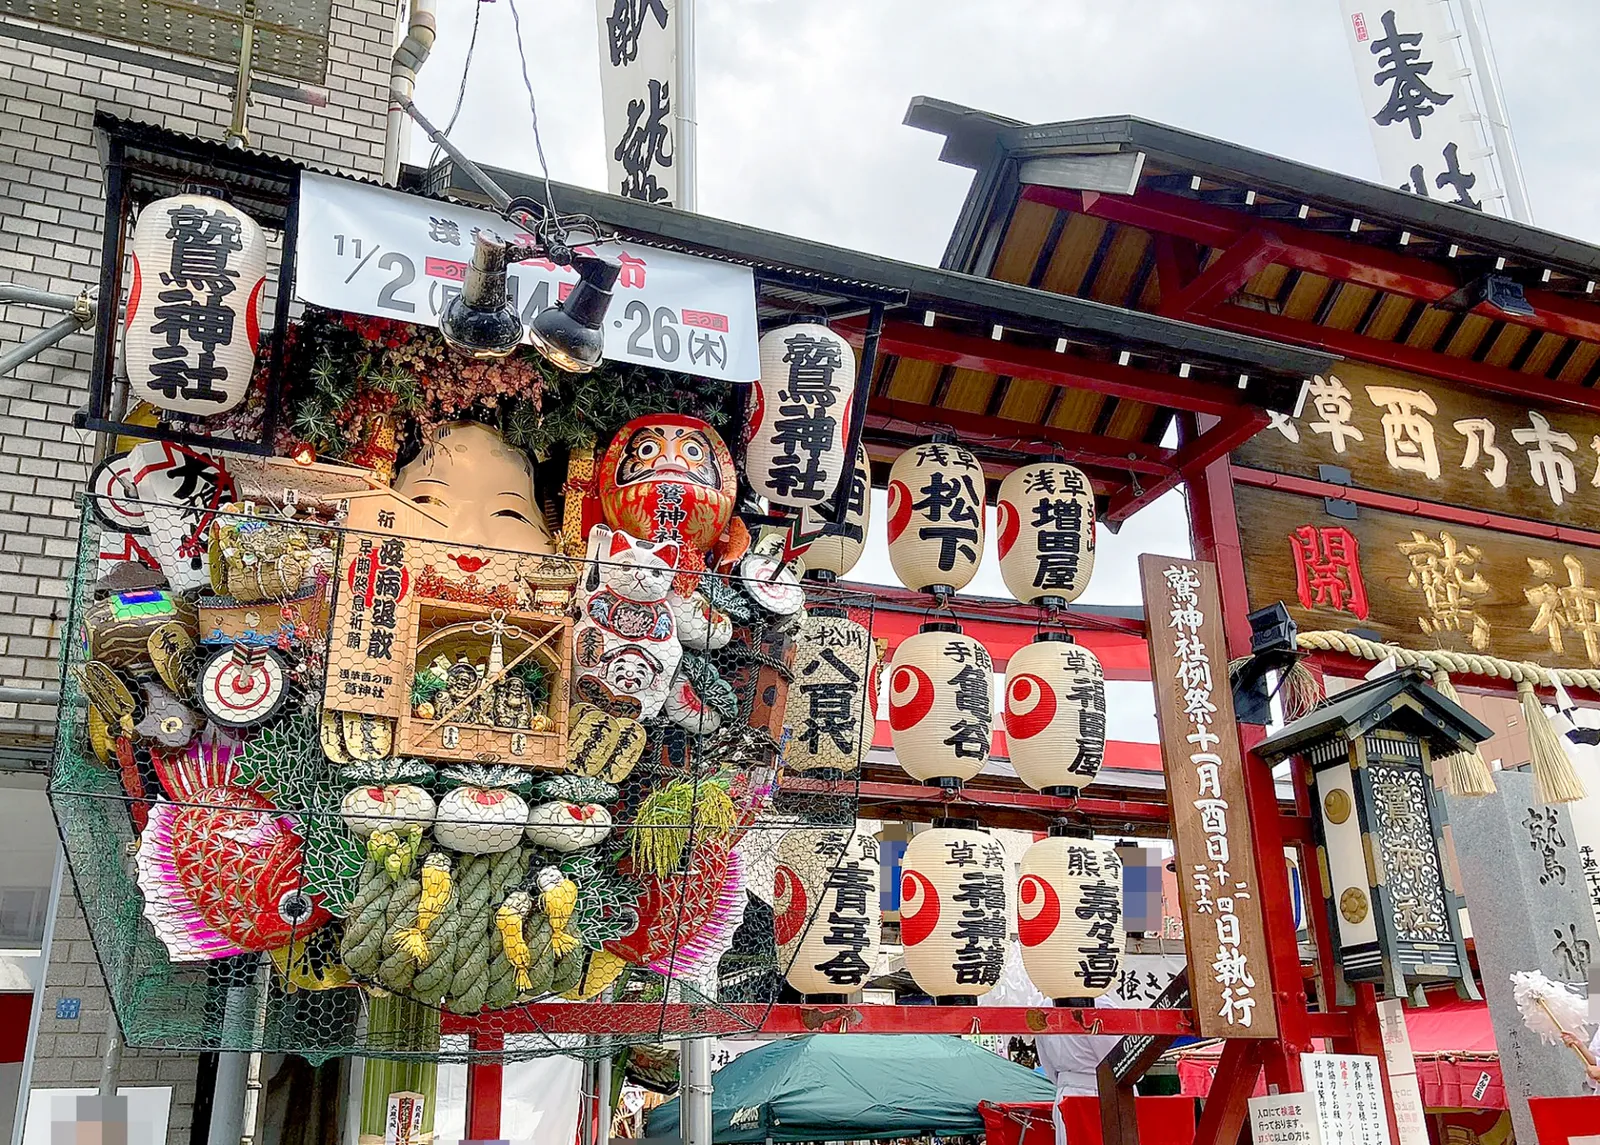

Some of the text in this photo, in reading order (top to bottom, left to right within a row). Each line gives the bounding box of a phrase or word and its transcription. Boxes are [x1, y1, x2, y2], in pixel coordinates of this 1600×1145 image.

[147, 205, 243, 403] 鷲神社
[765, 333, 842, 501] 鷲神社
[916, 445, 979, 471] 浅草
[1266, 373, 1600, 506] 草酉乃市
[377, 509, 396, 529] 祈
[912, 472, 979, 571] 松下
[1023, 468, 1087, 496] 浅草
[1031, 498, 1082, 591] 増田屋
[1288, 524, 1369, 621] 開
[347, 539, 373, 650] 早期終息祈願
[367, 538, 406, 661] 疫病退散
[344, 682, 385, 699] 鷲神社
[944, 665, 992, 761] 亀谷
[1380, 779, 1441, 933] 鷲神社
[814, 861, 876, 986] 青年会
[1257, 1105, 1302, 1119] 入口にて検温を
[1259, 1118, 1304, 1131] 行っております。
